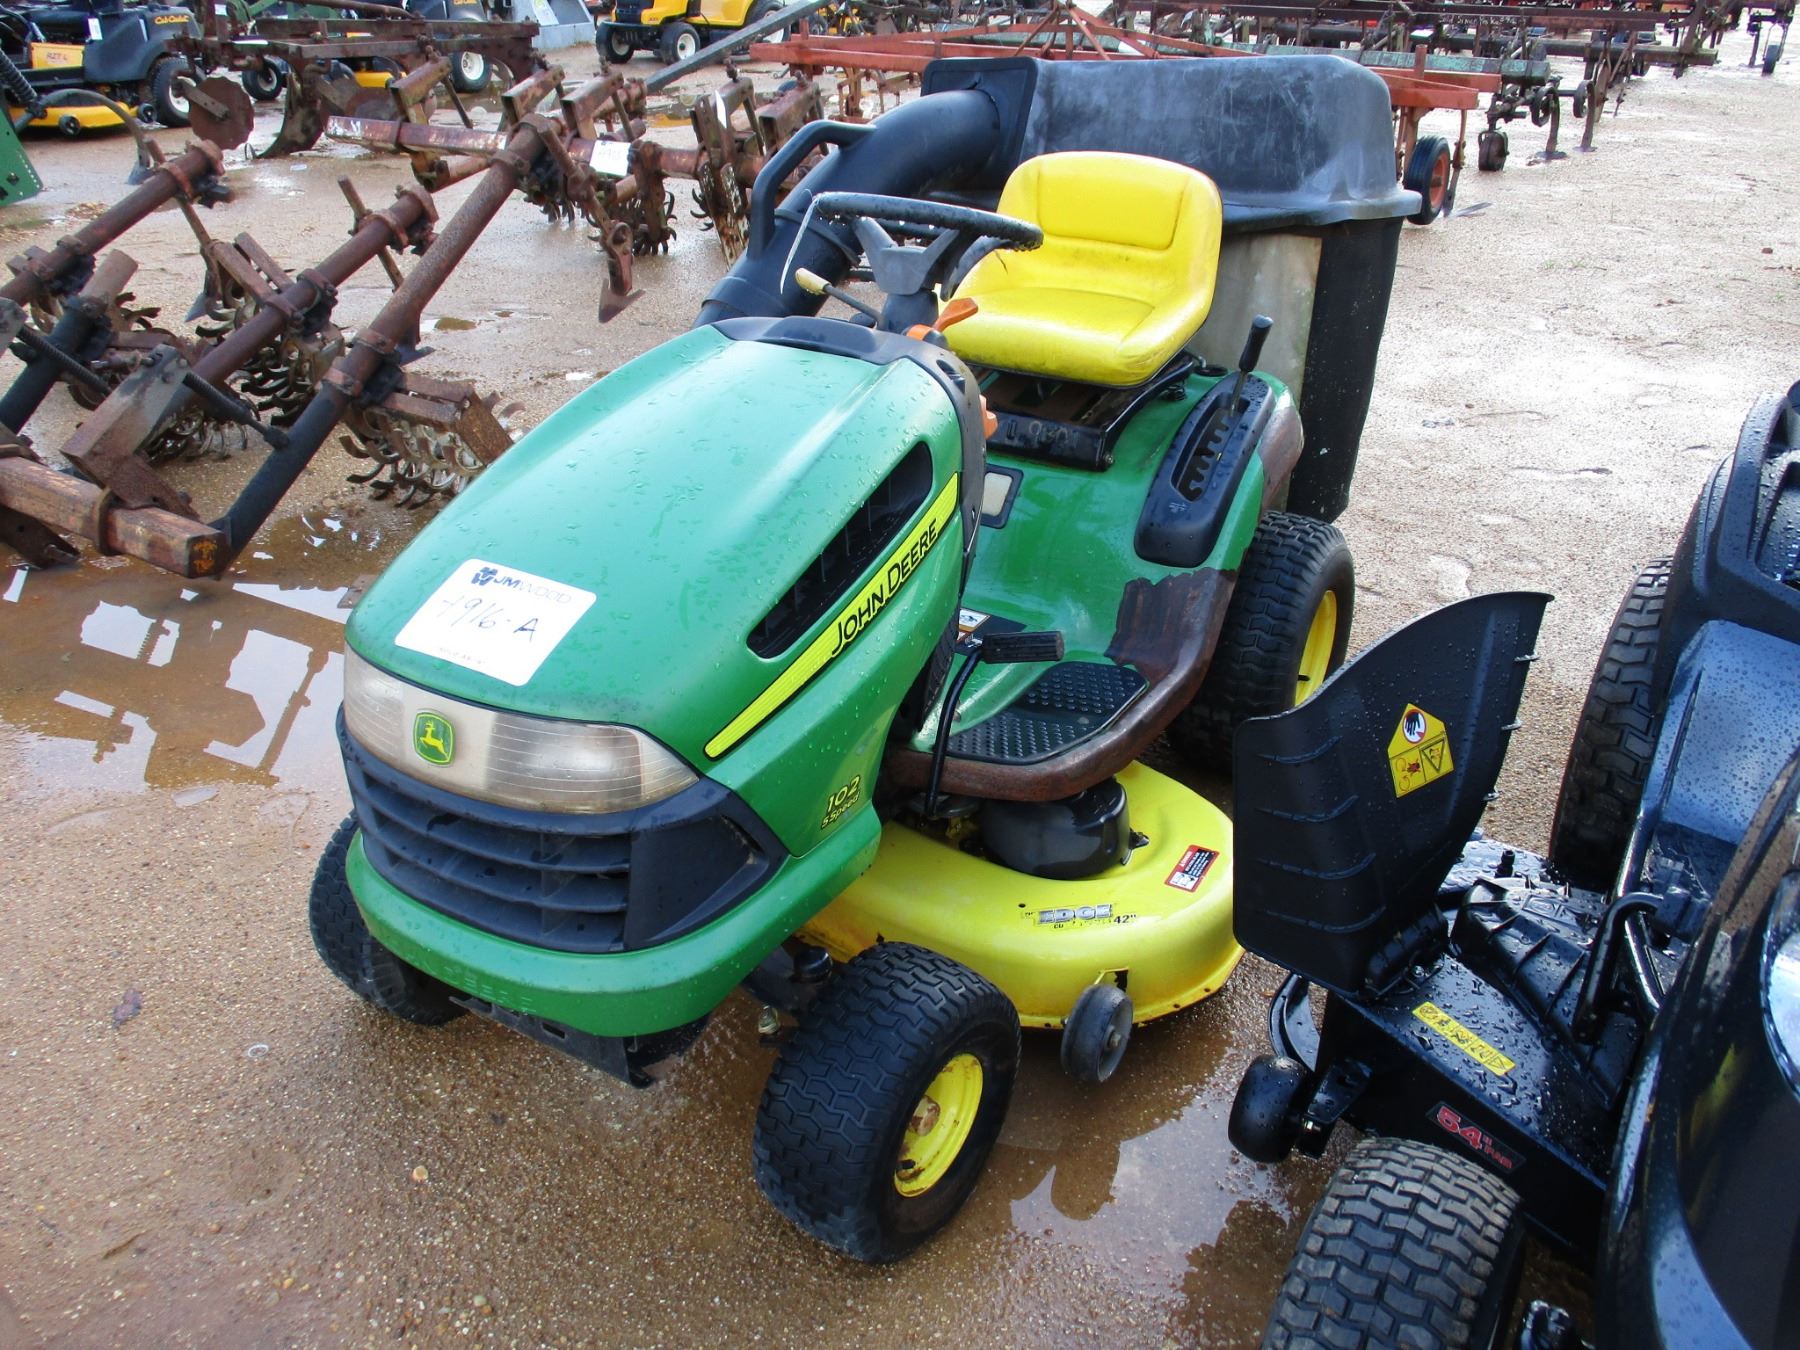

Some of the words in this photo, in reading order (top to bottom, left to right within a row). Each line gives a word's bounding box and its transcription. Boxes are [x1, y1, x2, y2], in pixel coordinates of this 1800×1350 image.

[832, 583, 884, 656] JOHN
[887, 518, 937, 595] DEERE
[827, 775, 860, 813] 102
[829, 791, 860, 822] Speed
[1038, 904, 1112, 924] EDGE
